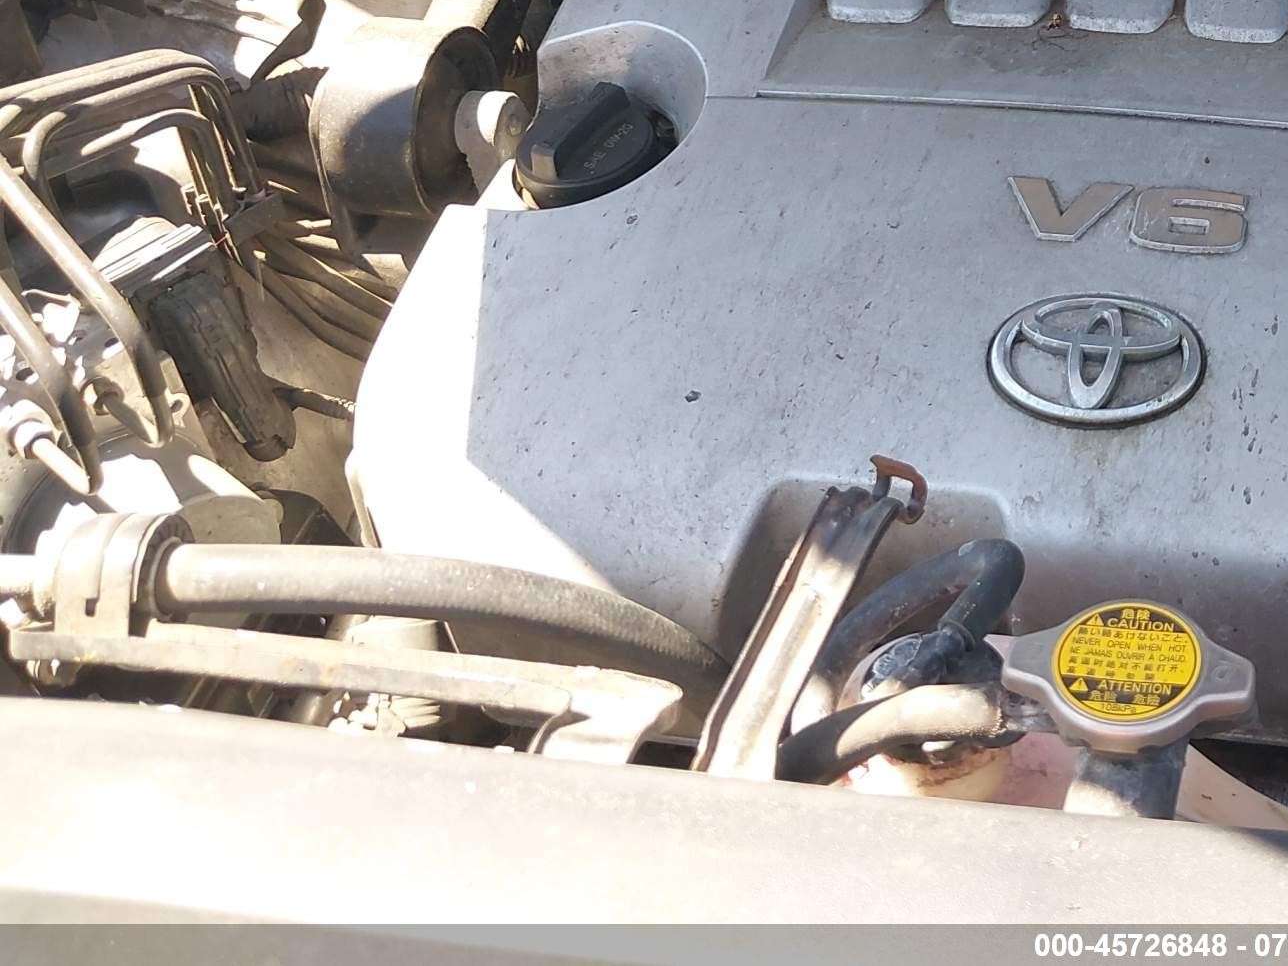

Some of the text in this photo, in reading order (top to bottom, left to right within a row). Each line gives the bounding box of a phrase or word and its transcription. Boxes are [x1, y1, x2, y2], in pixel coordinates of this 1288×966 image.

[1007, 175, 1249, 255] V6
[1107, 617, 1174, 632] CAUTION
[1072, 636, 1187, 653] NEVER OPEN WHEN HOT
[1070, 646, 1081, 654] NE
[1085, 648, 1113, 658] JAMAIS
[1116, 651, 1145, 661] OUVRIR
[1096, 679, 1172, 695] ATTENTION
